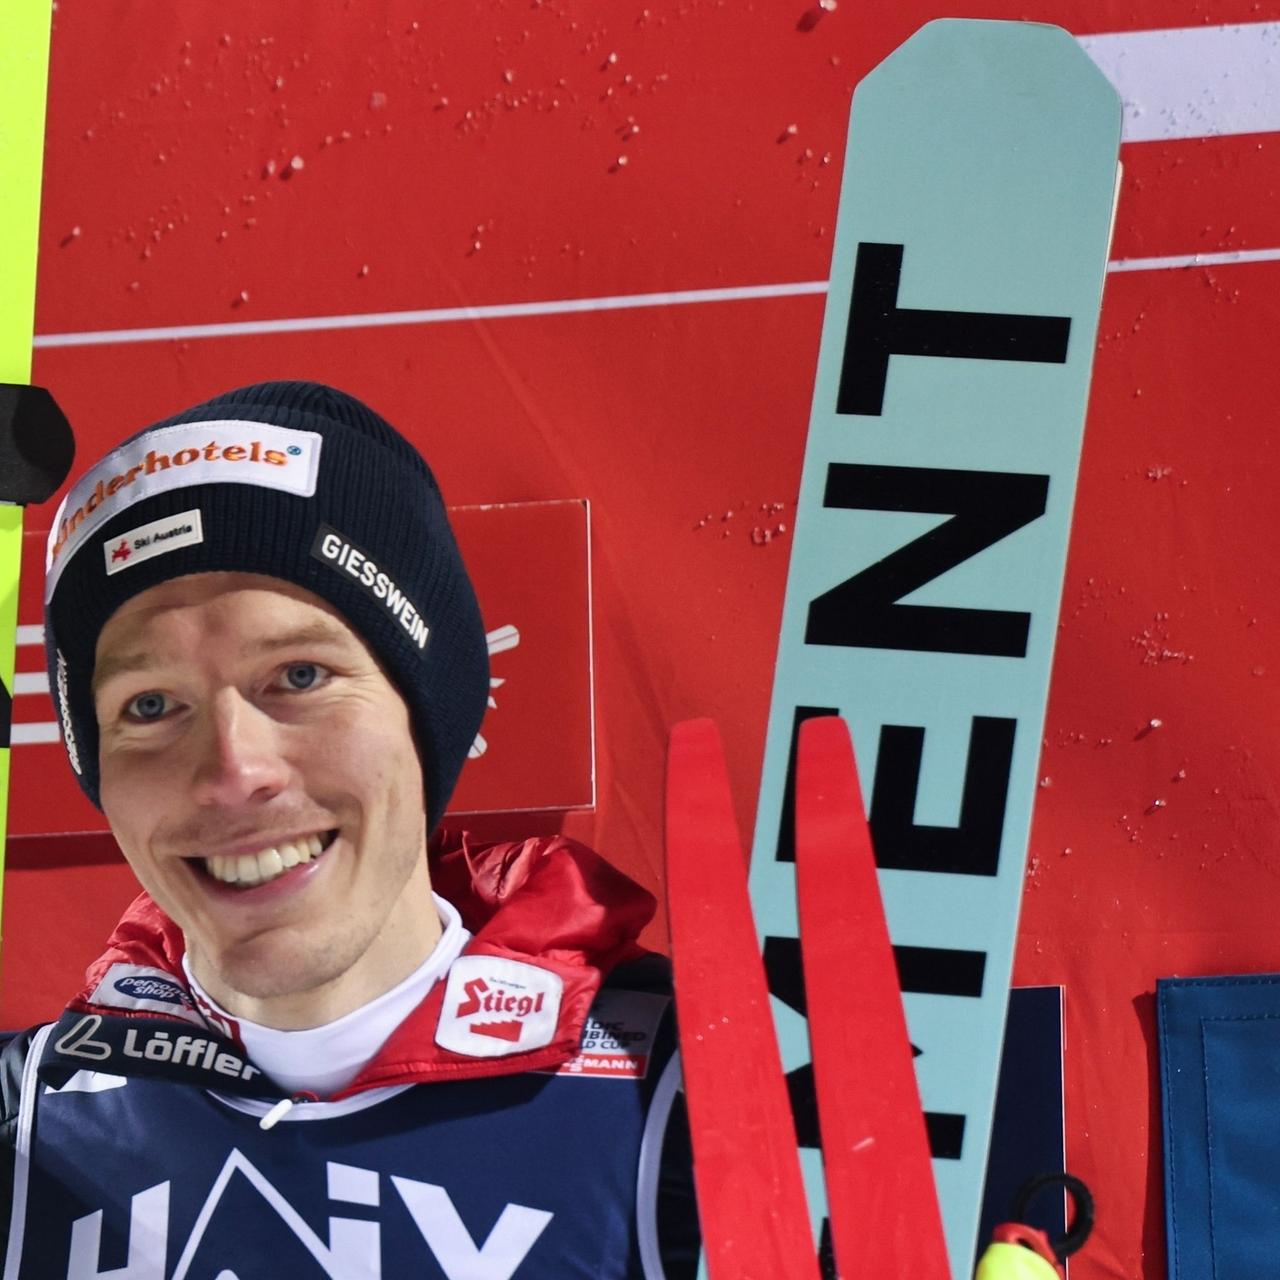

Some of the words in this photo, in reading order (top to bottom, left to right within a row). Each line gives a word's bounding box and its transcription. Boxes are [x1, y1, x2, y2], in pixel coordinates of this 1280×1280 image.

[133, 536, 151, 550] Ski
[153, 524, 192, 543] Austria
[321, 534, 429, 650] GIESSWEIN
[133, 986, 176, 999] shop
[456, 977, 544, 1018] Stiegl
[123, 1029, 262, 1081] Löffler
